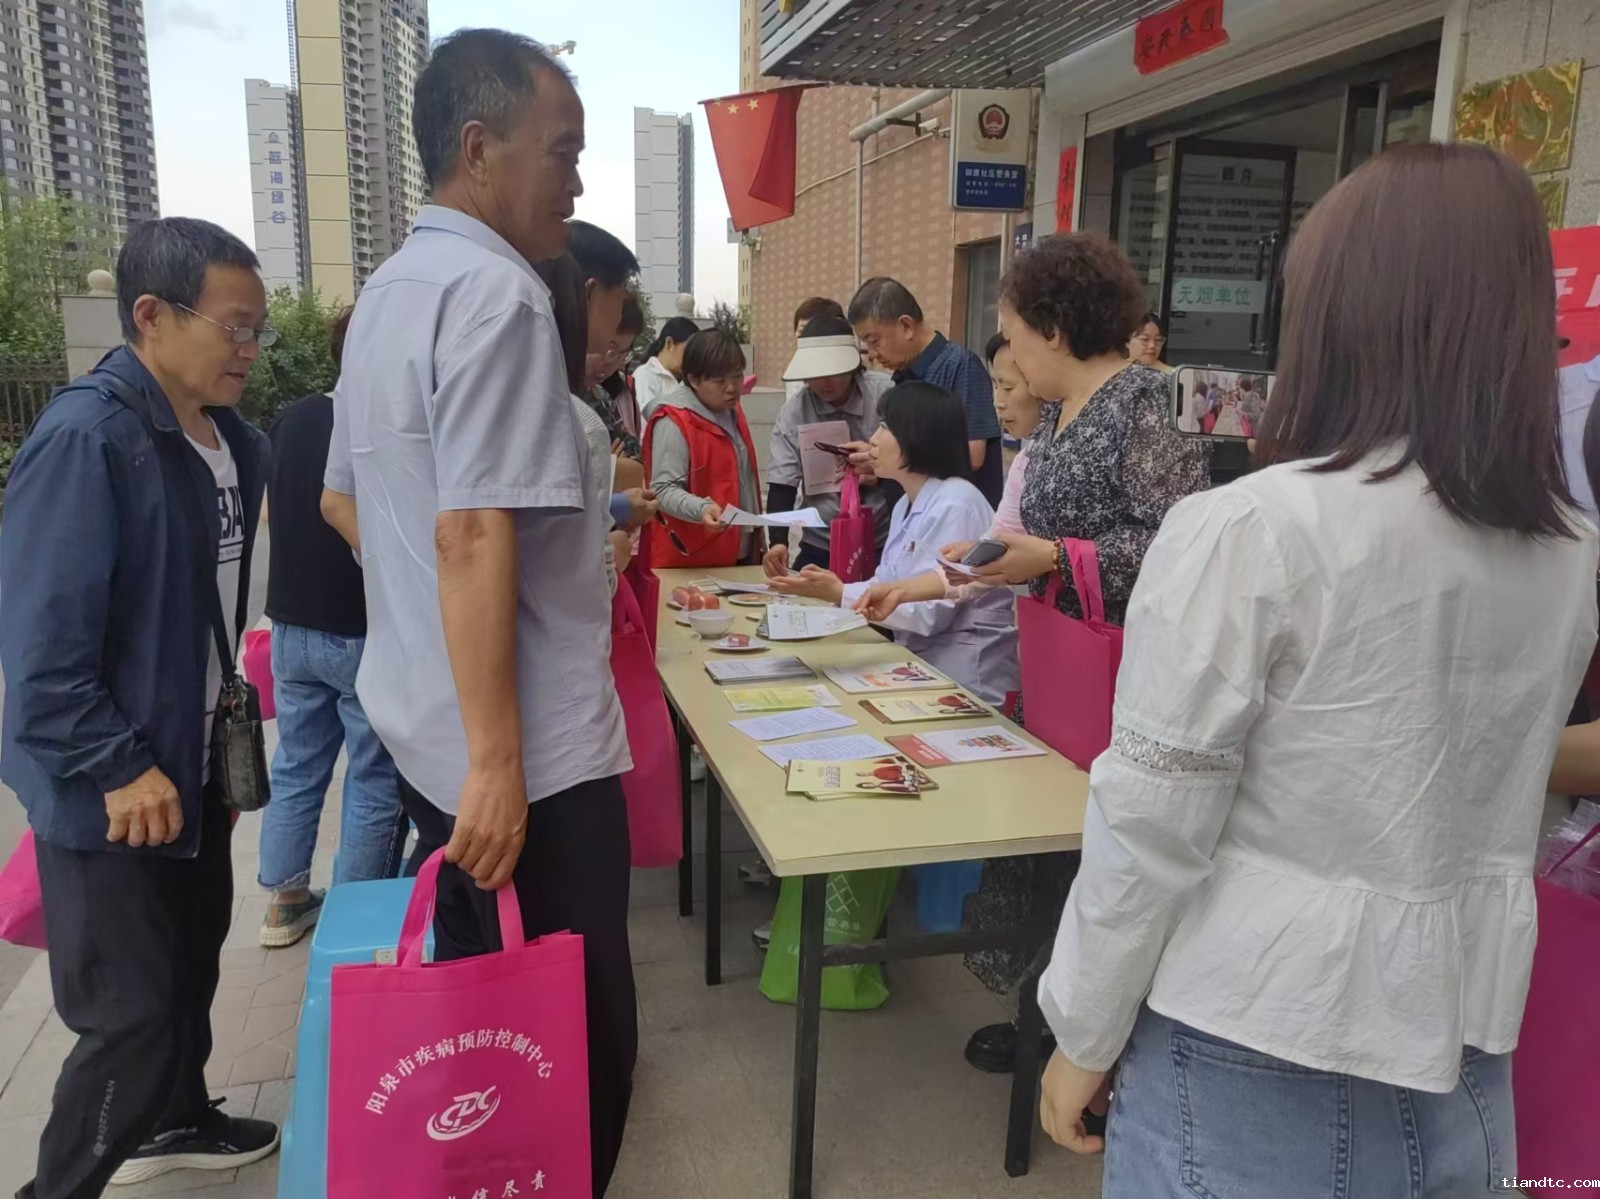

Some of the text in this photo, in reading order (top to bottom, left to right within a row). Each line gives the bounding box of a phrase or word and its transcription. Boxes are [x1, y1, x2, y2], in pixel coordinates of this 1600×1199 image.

[268, 150, 286, 224] 蓝海绿谷
[365, 1028, 553, 1115] 阳泉市疾病预防控制中心
